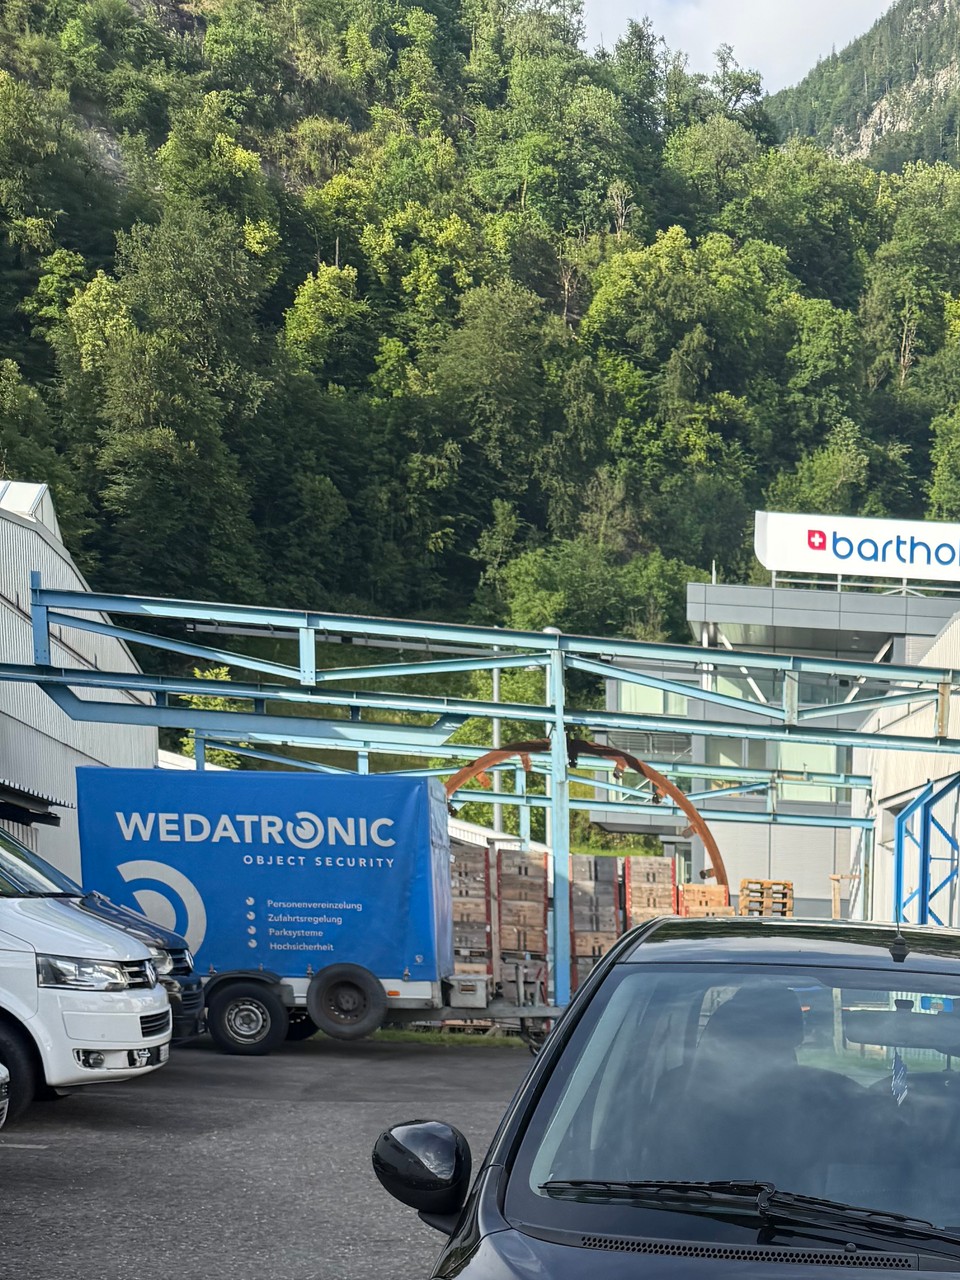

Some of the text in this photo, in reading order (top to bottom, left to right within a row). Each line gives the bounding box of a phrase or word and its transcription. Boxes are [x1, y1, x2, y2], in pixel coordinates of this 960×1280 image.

[115, 811, 396, 849] WEDATRONIC
[243, 855, 395, 868] OBJECT SECURITY
[267, 899, 363, 912] Personenvereinzelung
[267, 913, 343, 925] Zufahrtsregelung
[268, 928, 324, 938] Parksysteme
[269, 942, 334, 952] Hochsicherheit
